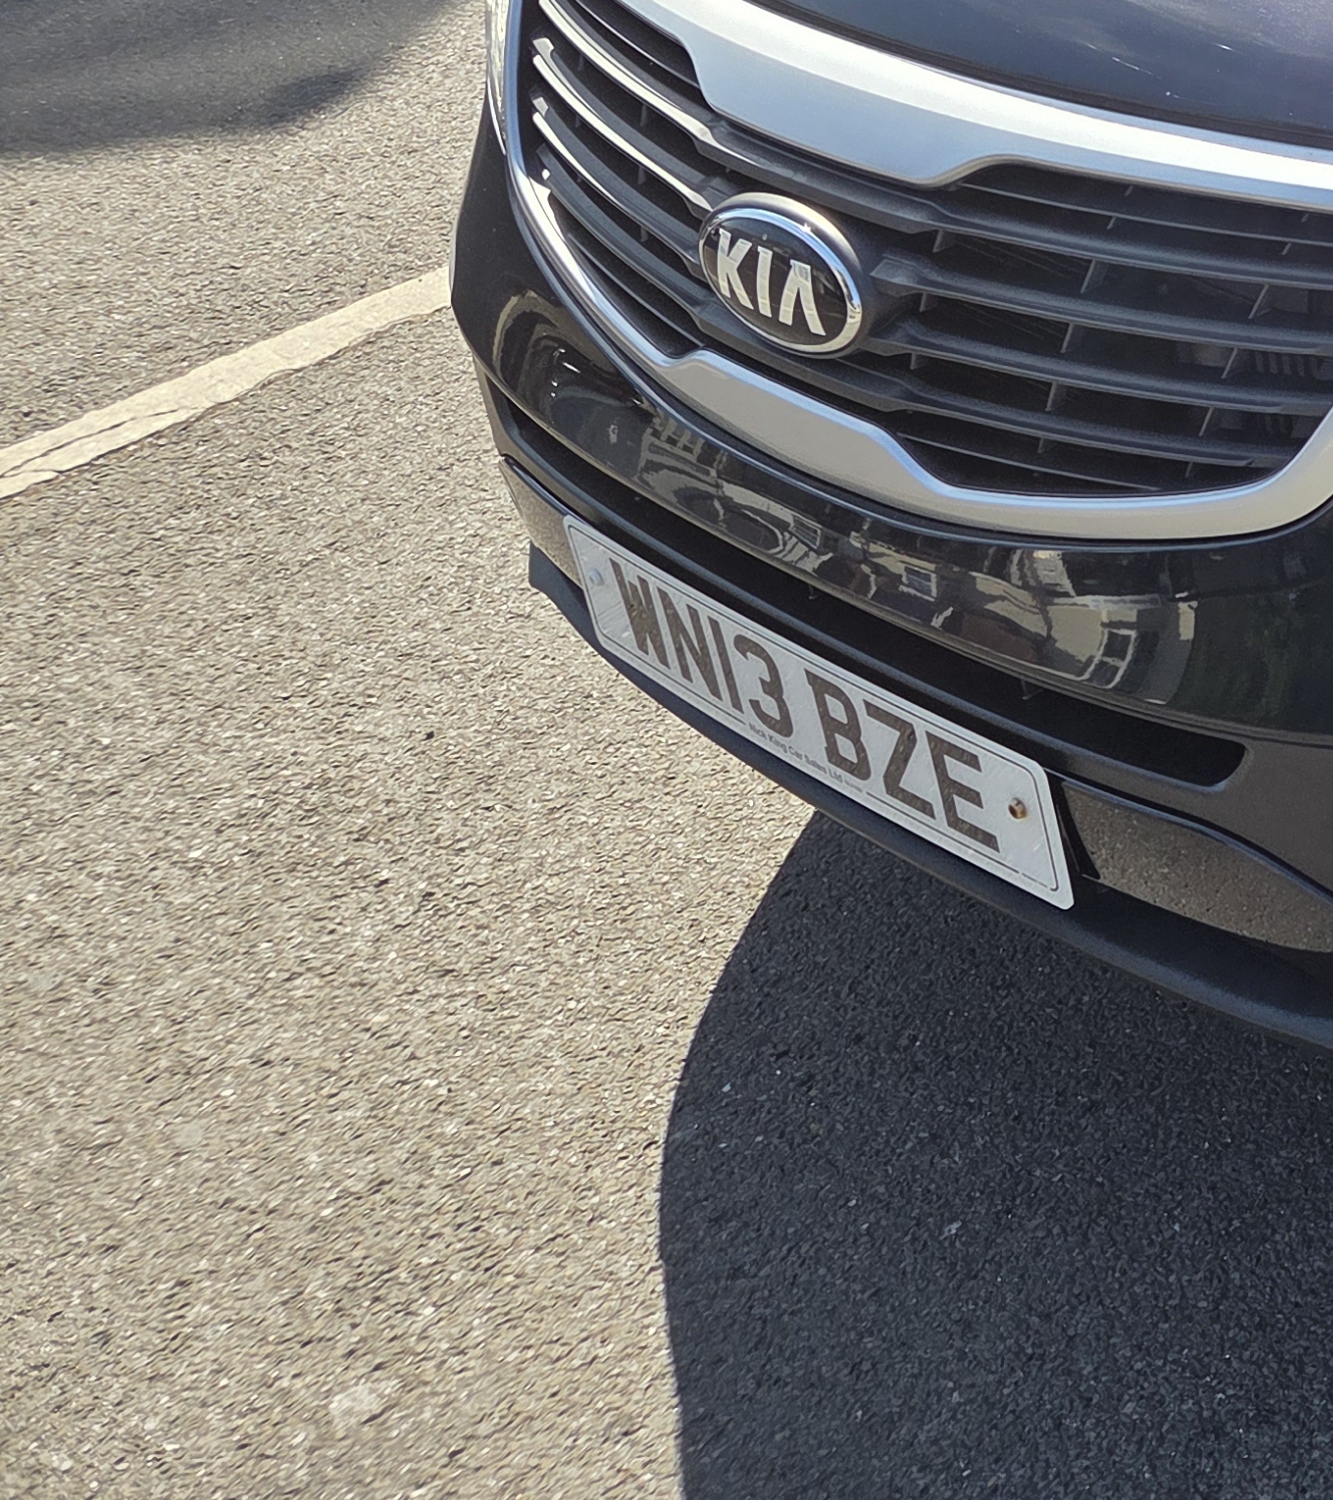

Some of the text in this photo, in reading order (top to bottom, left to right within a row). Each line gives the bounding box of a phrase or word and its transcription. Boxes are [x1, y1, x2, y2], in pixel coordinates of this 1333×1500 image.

[717, 227, 826, 336] KIA
[608, 556, 1000, 854] WN13 BZE
